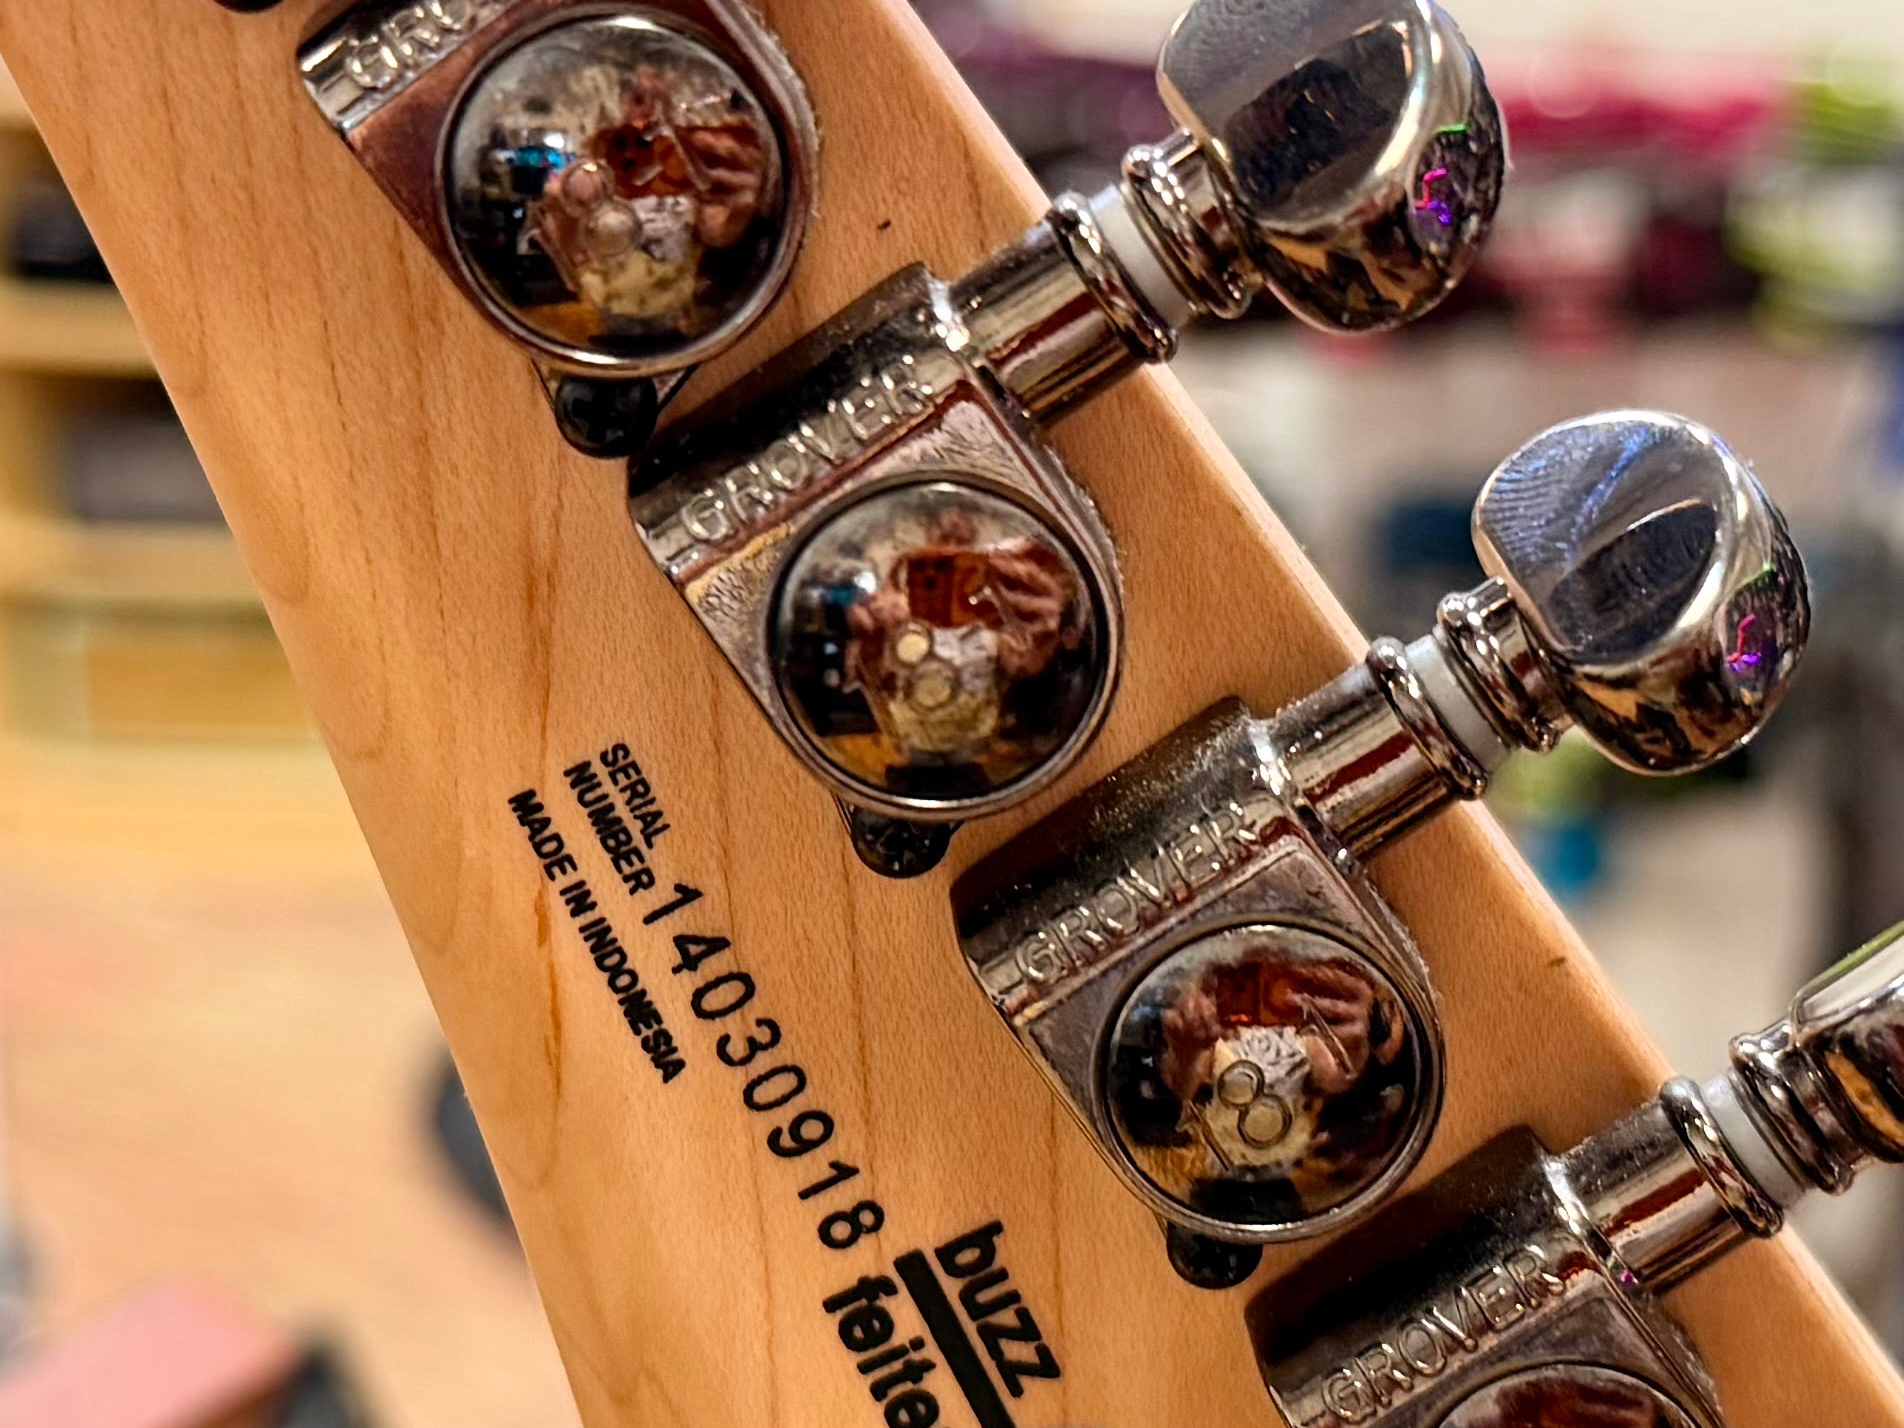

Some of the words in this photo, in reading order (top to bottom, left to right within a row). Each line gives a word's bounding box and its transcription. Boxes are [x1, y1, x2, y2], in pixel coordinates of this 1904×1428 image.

[680, 355, 935, 542] GROVER
[508, 789, 578, 882] MADE
[564, 760, 656, 895] NUMBER
[600, 742, 671, 850] SERIAL
[559, 880, 599, 918] IN
[1015, 801, 1260, 982] GROVER
[578, 916, 686, 1084] INDONESIA
[642, 882, 885, 1250] 14030918
[935, 1220, 1061, 1399] buzz
[1320, 1244, 1567, 1423] GROVER
